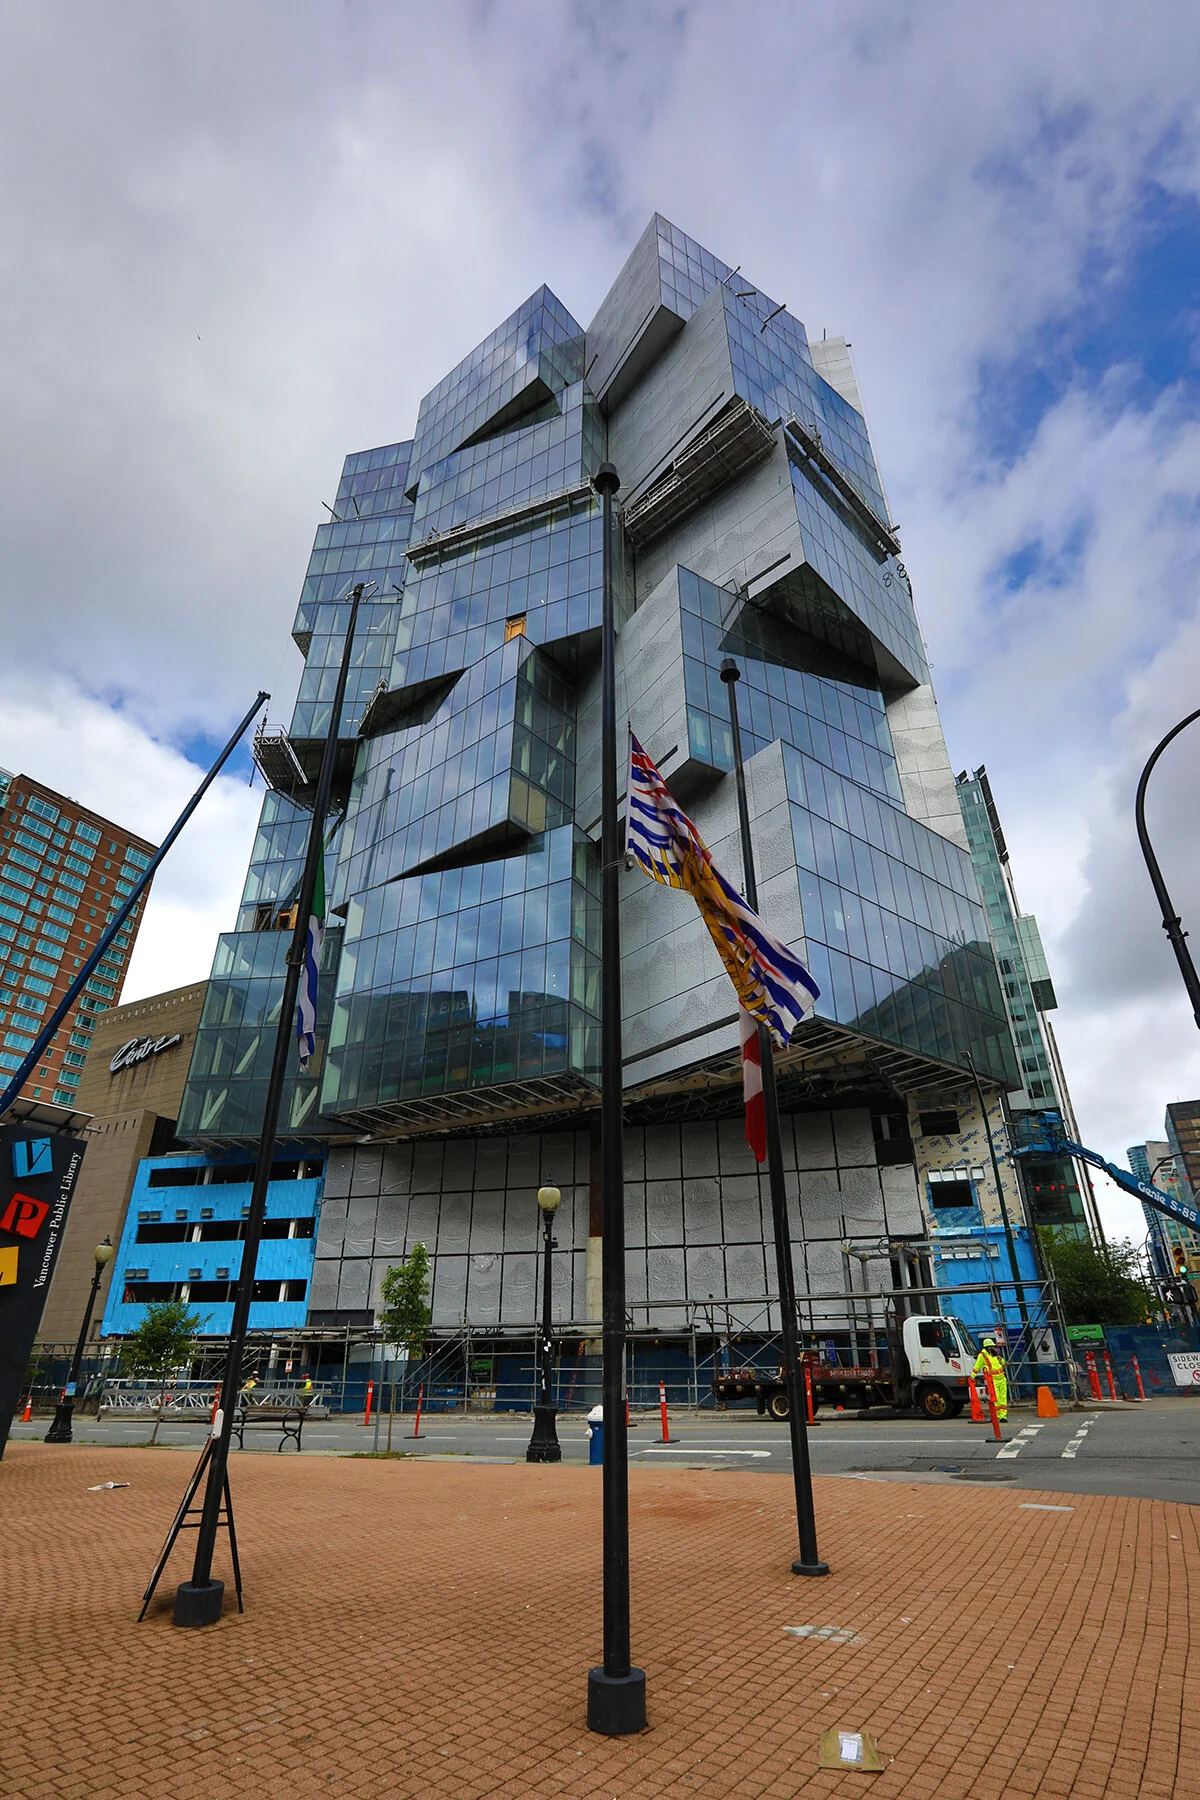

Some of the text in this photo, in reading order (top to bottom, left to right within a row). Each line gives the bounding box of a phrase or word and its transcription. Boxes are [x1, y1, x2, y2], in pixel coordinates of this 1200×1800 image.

[110, 1034, 180, 1071] Centre
[33, 1152, 82, 1288] Vancouver Public Library
[1138, 1181, 1197, 1222] Genie S-85
